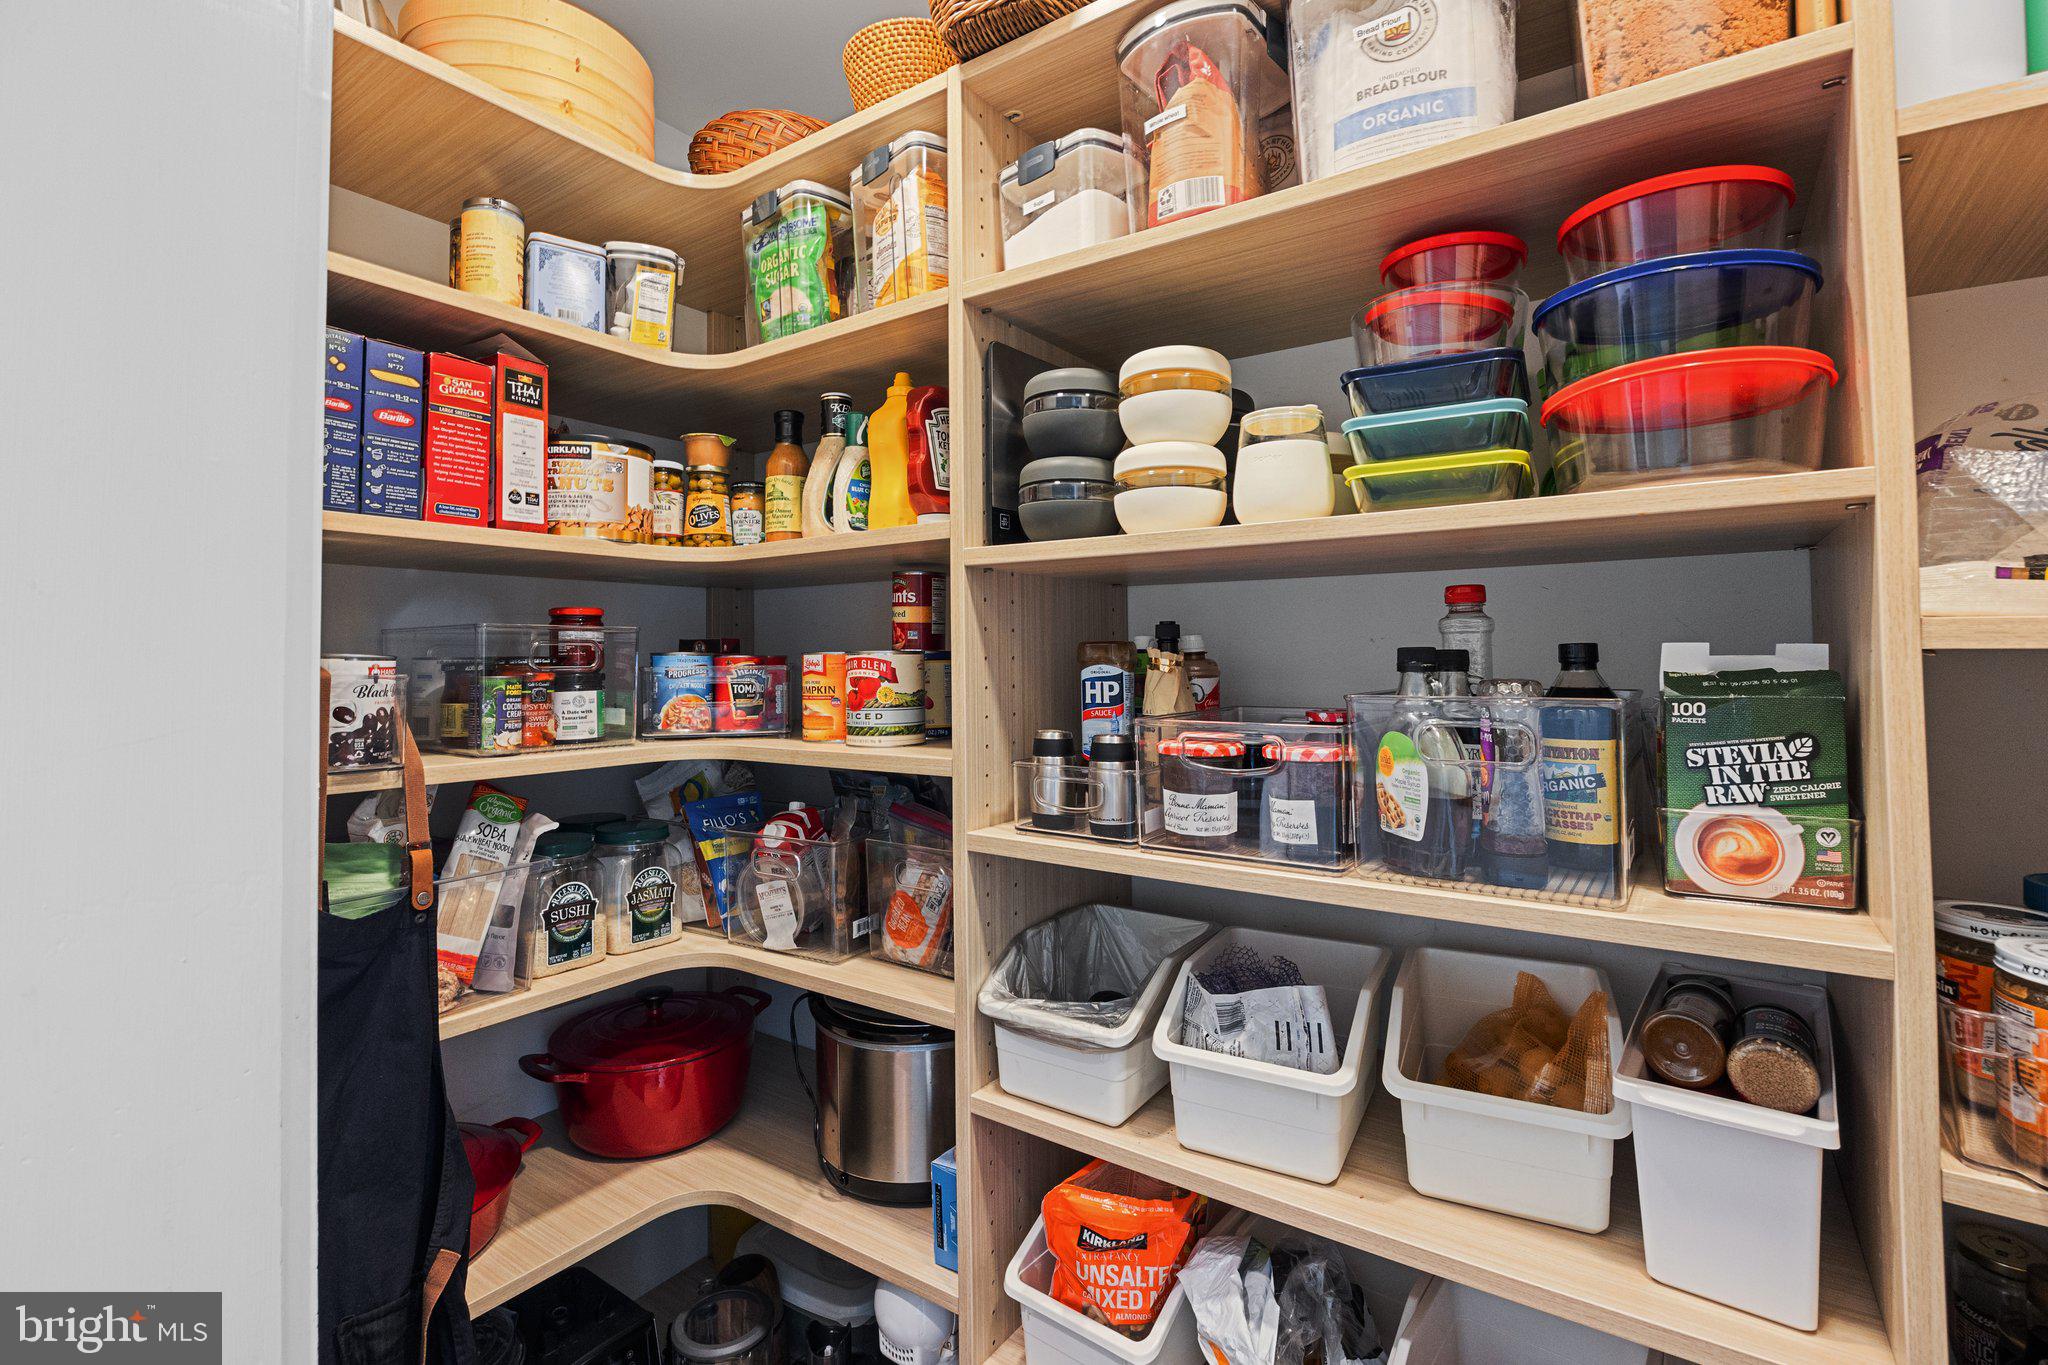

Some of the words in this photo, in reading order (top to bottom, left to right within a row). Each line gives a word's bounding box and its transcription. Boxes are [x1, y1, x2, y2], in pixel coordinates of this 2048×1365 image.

[1356, 23, 1380, 38] Bread
[1381, 15, 1402, 29] Flour
[1379, 67, 1420, 81] UNBLEACHED
[1356, 80, 1399, 102] BREAD
[1402, 69, 1448, 87] FLOUR
[1362, 99, 1444, 130] ORGANIC
[761, 244, 808, 274] ORGANIC
[765, 262, 800, 289] SUGAR
[439, 383, 485, 398] GIORGIO
[451, 379, 472, 389] SAN
[506, 380, 541, 400] THAI
[511, 395, 538, 405] KITCHEN
[439, 406, 454, 414] LARGE
[378, 412, 411, 424] Barilla
[689, 510, 720, 526] OLIVES
[737, 668, 766, 676] HEINZ
[861, 659, 887, 672] GLEN
[668, 668, 707, 679] PROGRESSO
[352, 684, 389, 698] Black
[1084, 680, 1120, 703] HP
[1090, 708, 1112, 716] SAUCE
[1671, 702, 1706, 716] 100
[1686, 742, 1793, 768] STEVIA
[1708, 765, 1742, 785] IN
[1745, 760, 1811, 783] THE
[1703, 783, 1767, 805] RAW
[1772, 786, 1798, 794] ZERO
[1800, 782, 1842, 792] CALORIE
[1168, 794, 1190, 809] Bonne
[1191, 798, 1226, 810] Maman
[1769, 791, 1827, 802] SWEETENER
[480, 802, 517, 820] Organic
[1164, 807, 1190, 822] Apricot
[1193, 811, 1231, 823] Preserves
[1275, 816, 1309, 830] Preserves
[476, 821, 507, 842] SOBA
[630, 886, 672, 905] JASMATI
[1810, 888, 1822, 897] OZ.
[1823, 890, 1845, 900] (100g)
[550, 903, 591, 923] SUSHI
[1109, 1252, 1140, 1262] FANCY
